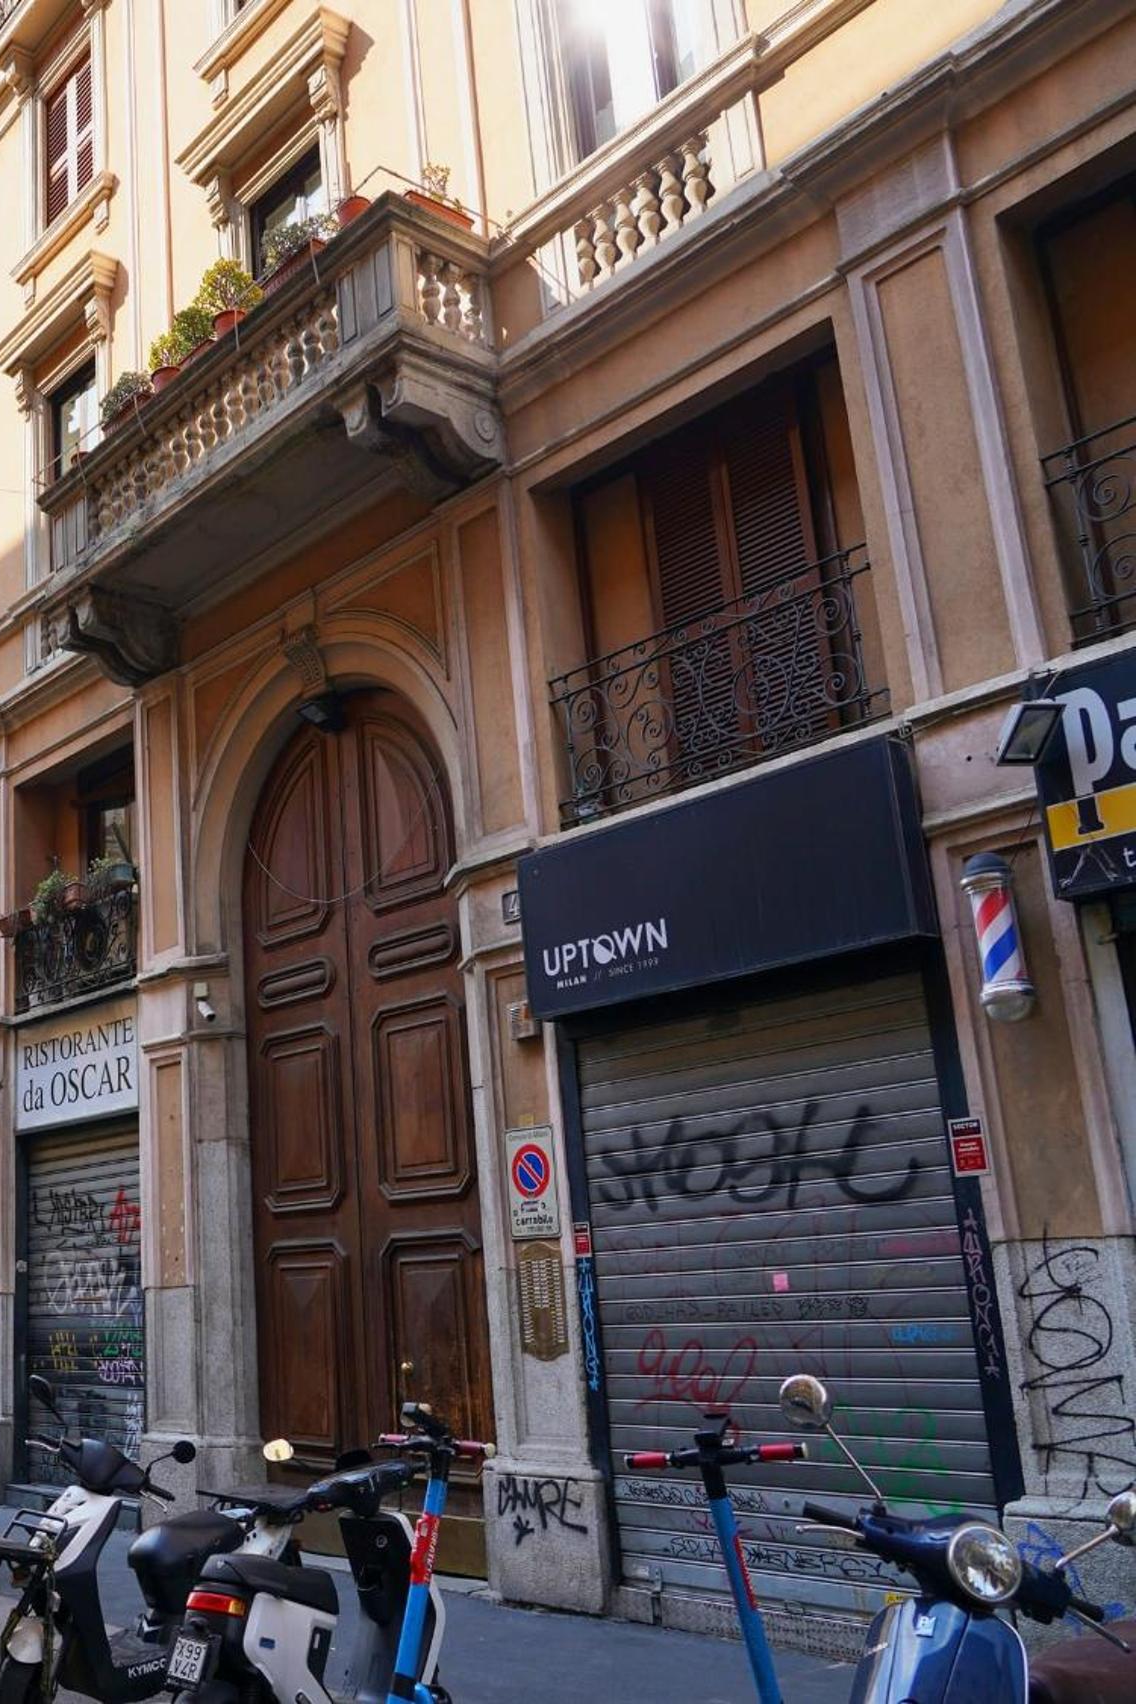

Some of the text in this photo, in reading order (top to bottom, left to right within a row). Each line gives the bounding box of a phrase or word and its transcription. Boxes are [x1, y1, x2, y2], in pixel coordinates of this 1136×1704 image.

[543, 918, 668, 977] UPTOWN
[557, 975, 587, 989] MILAN
[608, 962, 634, 978] SINCE
[24, 1016, 135, 1070] RISTORANTE
[24, 1056, 133, 1112] da OSCAR
